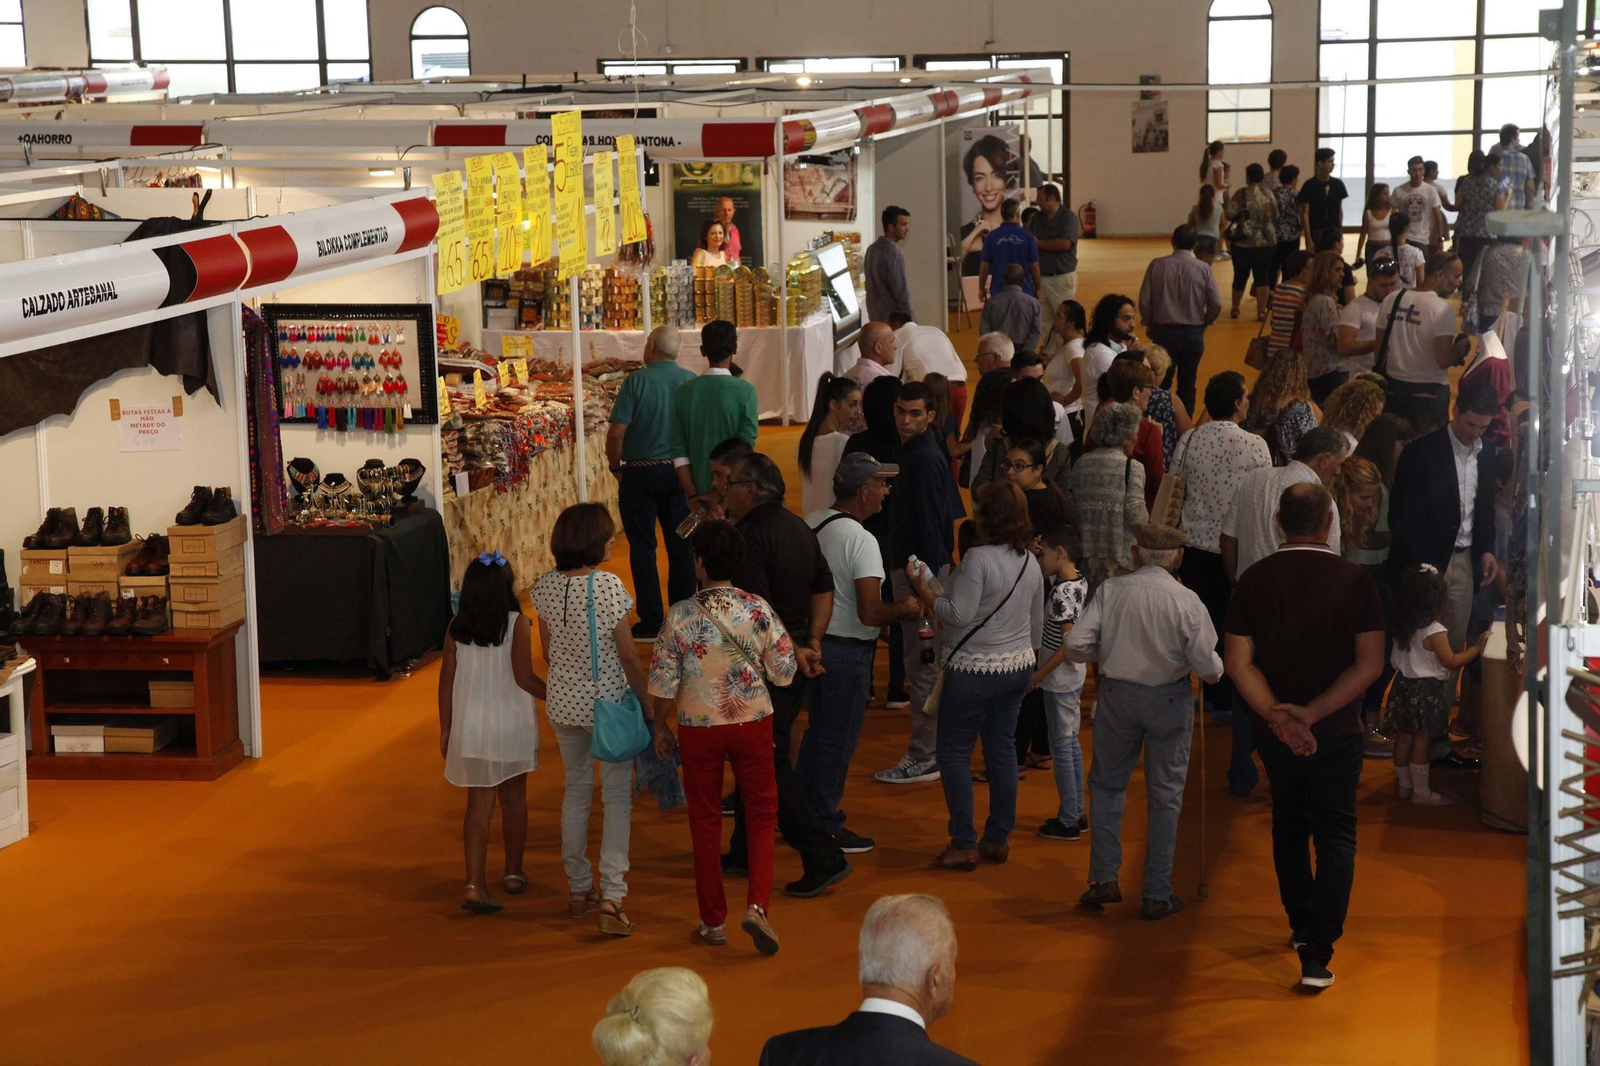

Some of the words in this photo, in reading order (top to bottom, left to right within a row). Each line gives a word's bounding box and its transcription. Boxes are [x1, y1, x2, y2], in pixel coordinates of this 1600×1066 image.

[554, 142, 567, 193] 5
[343, 226, 389, 252] COMPLEMENTOS
[21, 291, 66, 319] CALZADO
[66, 281, 118, 310] ARTESANAL
